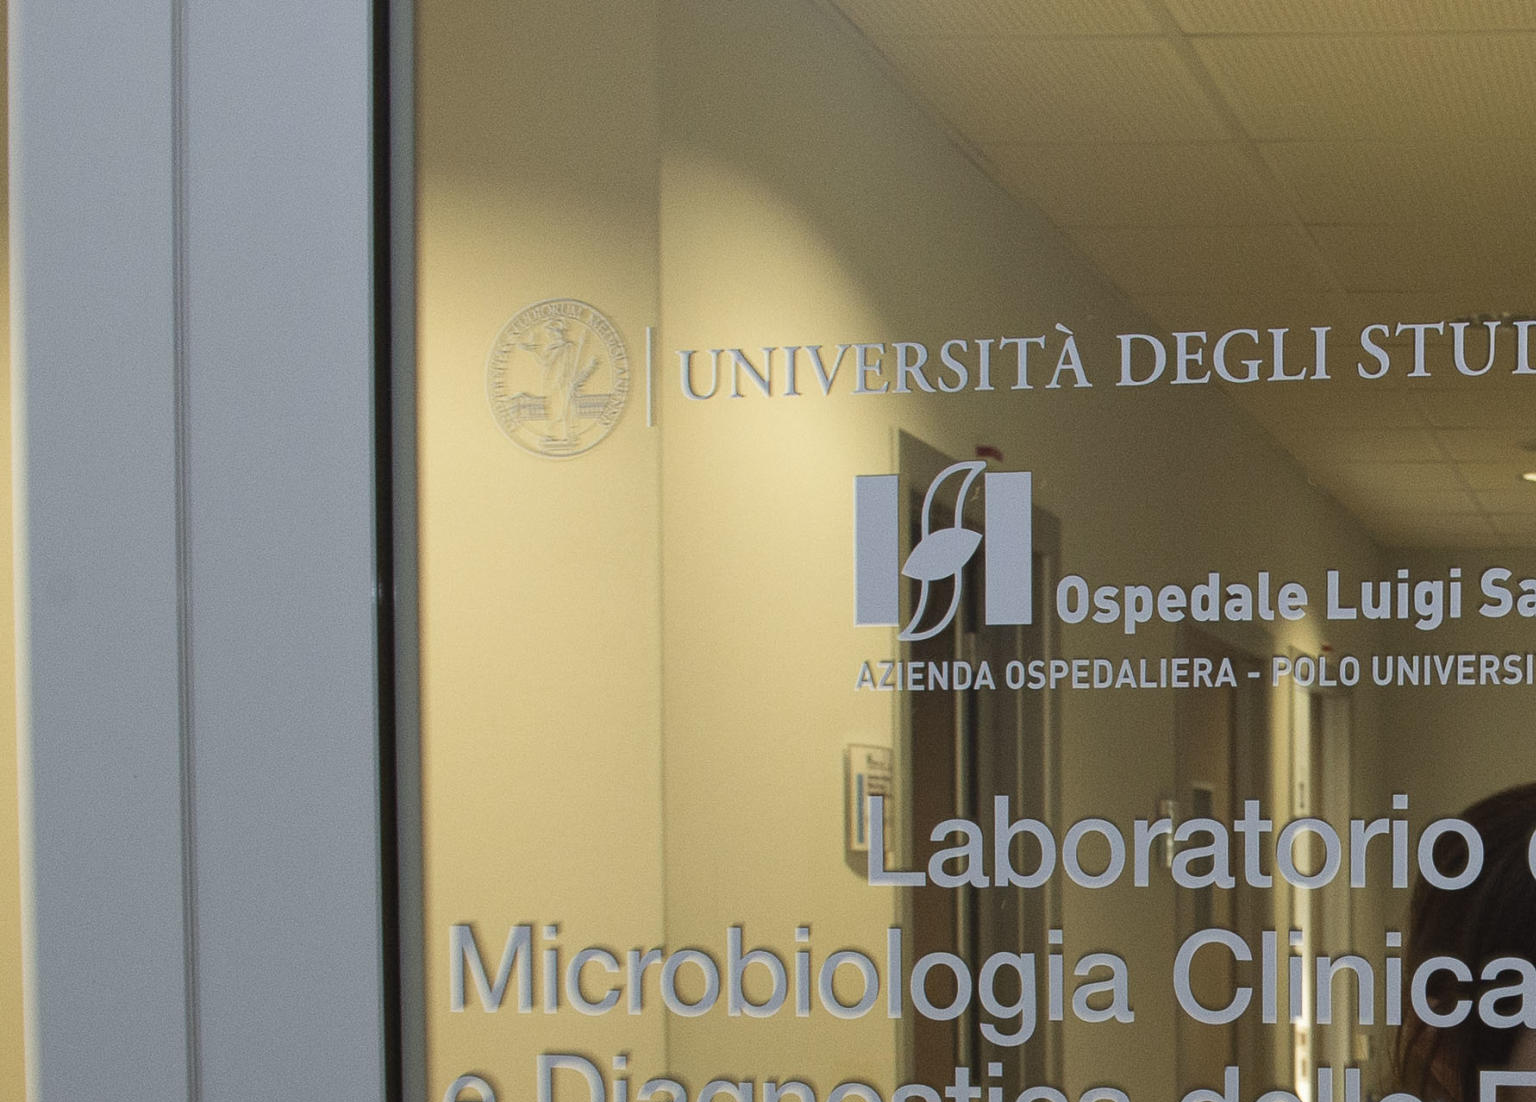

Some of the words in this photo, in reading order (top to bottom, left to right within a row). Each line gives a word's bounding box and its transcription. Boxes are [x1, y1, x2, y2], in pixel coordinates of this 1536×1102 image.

[678, 323, 1093, 400] UNIVERSITÀ
[1116, 326, 1331, 388] DEGLI
[1056, 571, 1308, 634] Ospedale
[1327, 567, 1462, 631] Luigi
[855, 659, 996, 692] AZIENDA
[1006, 657, 1237, 690] OSPEDALIERA
[1272, 656, 1360, 688] POLO
[868, 794, 1484, 891] Laboratorio
[448, 924, 1134, 1047] Microbiologia
